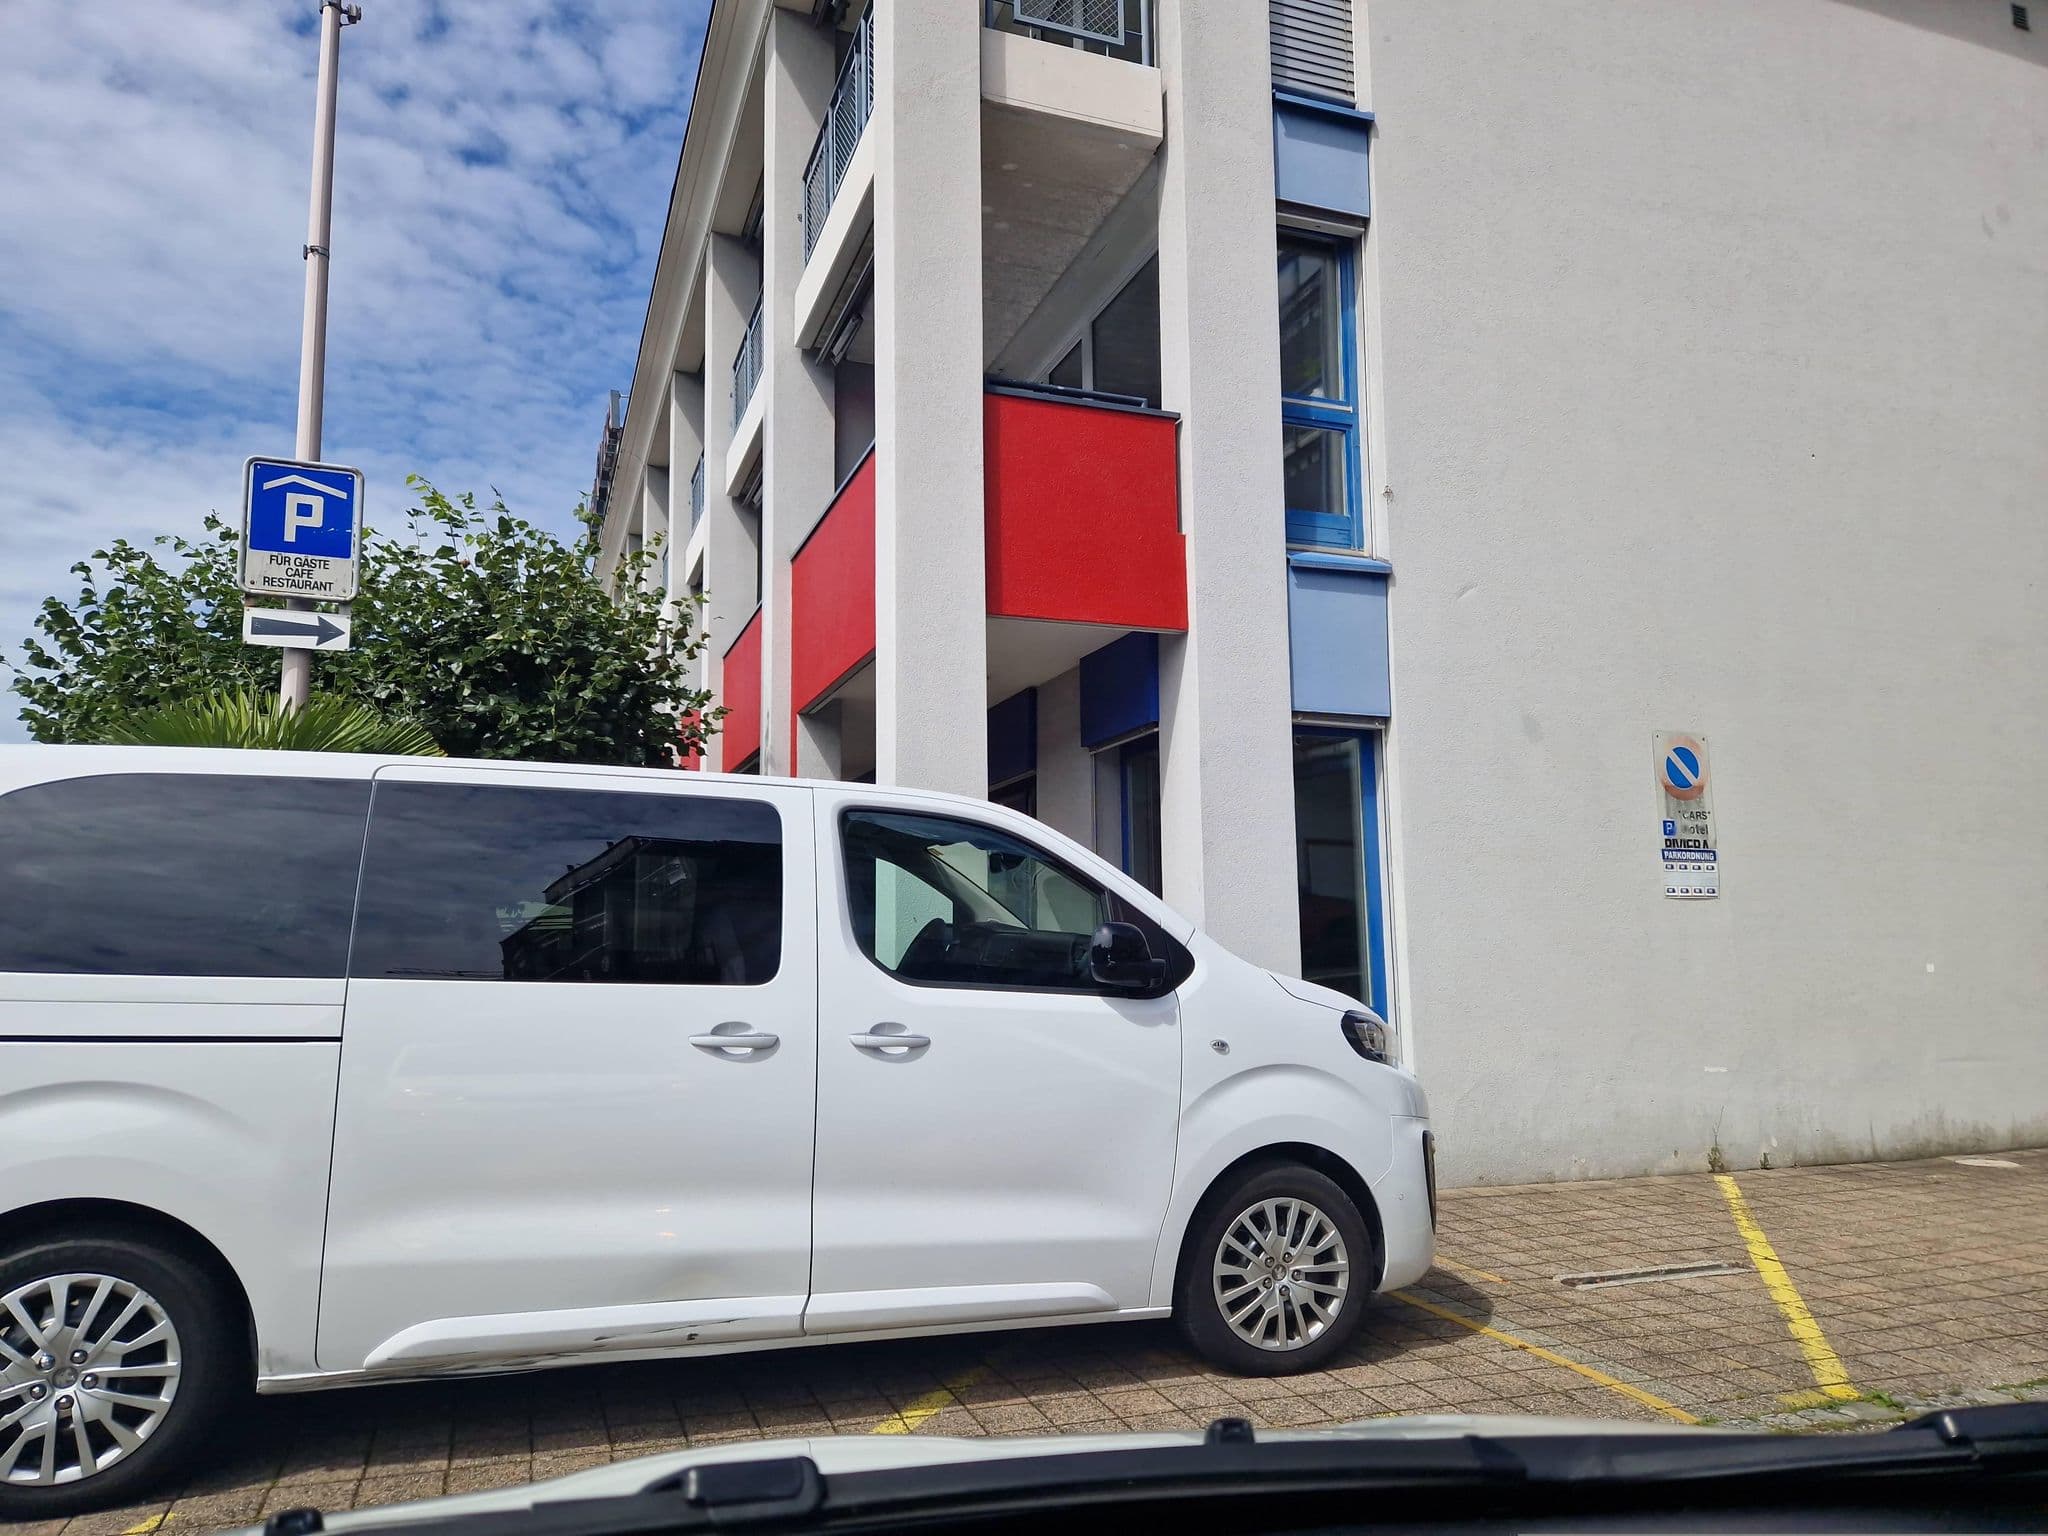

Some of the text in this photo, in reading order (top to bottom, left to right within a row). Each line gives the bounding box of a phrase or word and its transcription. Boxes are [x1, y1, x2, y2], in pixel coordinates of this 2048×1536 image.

[283, 492, 324, 543] P
[269, 552, 330, 570] FÜR GÄSTE
[285, 567, 314, 580] CAFE
[262, 576, 334, 592] RESTAURANT
[1663, 850, 1714, 861] PARKORDNUNG
